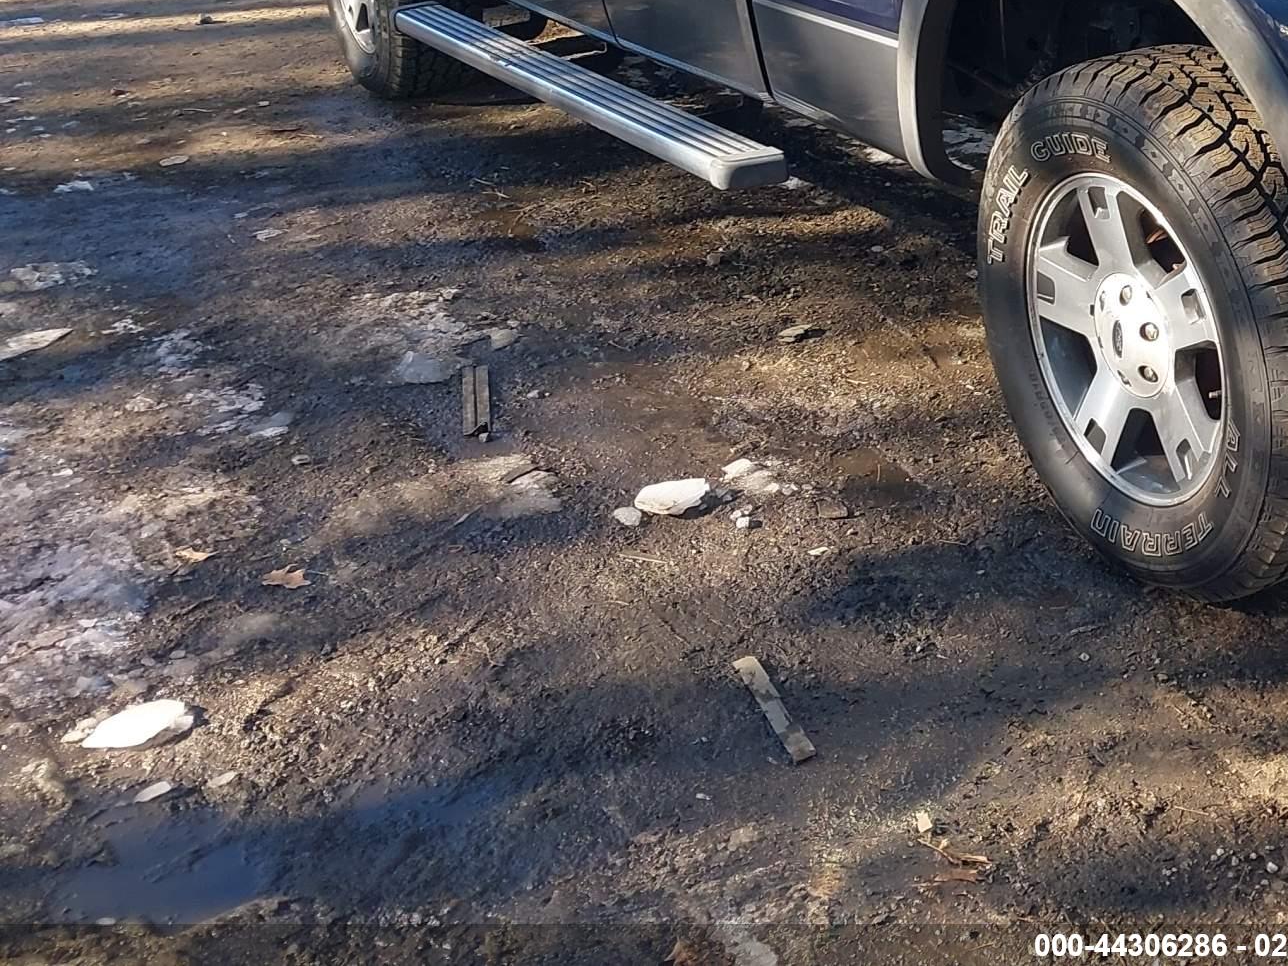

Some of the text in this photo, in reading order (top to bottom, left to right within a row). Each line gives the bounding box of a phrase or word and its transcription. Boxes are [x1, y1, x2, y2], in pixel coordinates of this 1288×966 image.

[987, 132, 1111, 265] TRAIL GUIDE
[1090, 418, 1241, 557] ALL TERRAIN
